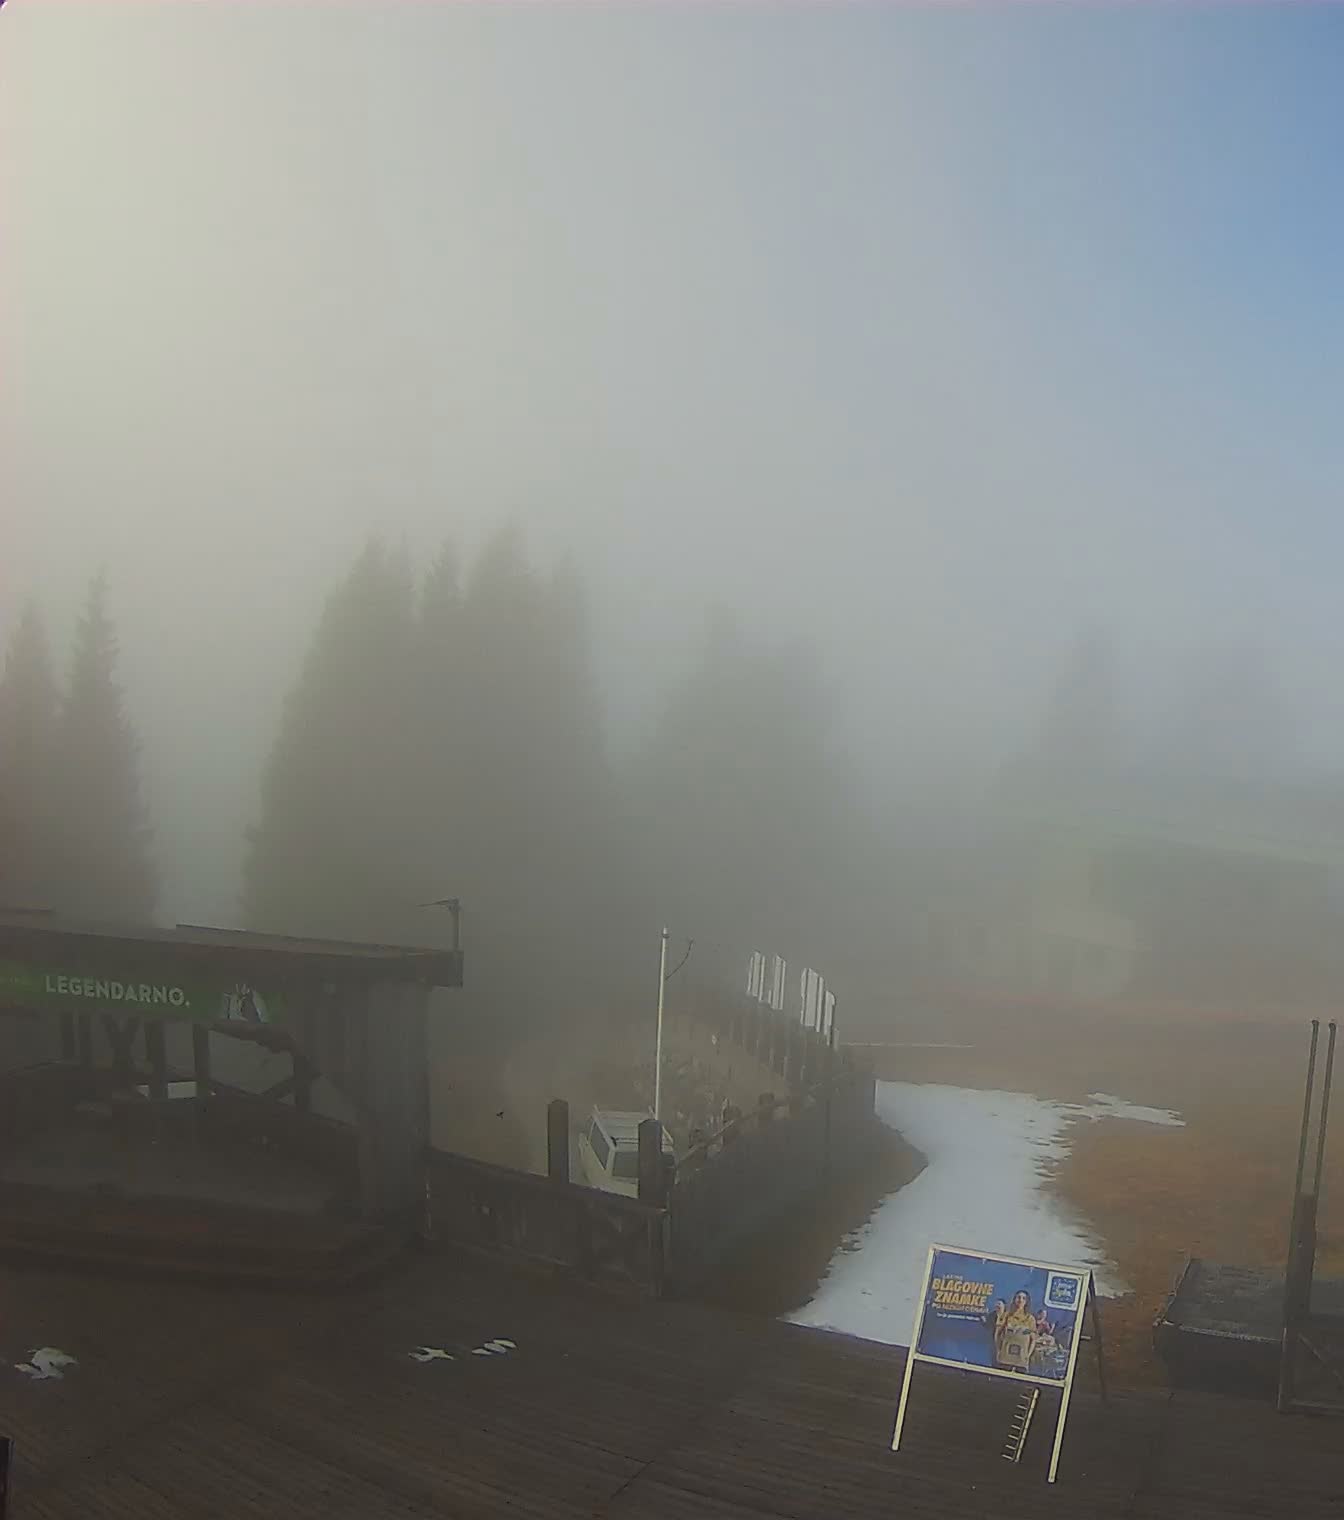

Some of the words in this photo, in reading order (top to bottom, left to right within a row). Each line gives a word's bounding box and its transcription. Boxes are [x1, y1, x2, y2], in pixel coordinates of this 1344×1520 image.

[45, 975, 190, 1008] LEGENDARNO.
[932, 1278, 994, 1296] BLAGOVNE
[934, 1290, 987, 1307] ZNAMKE
